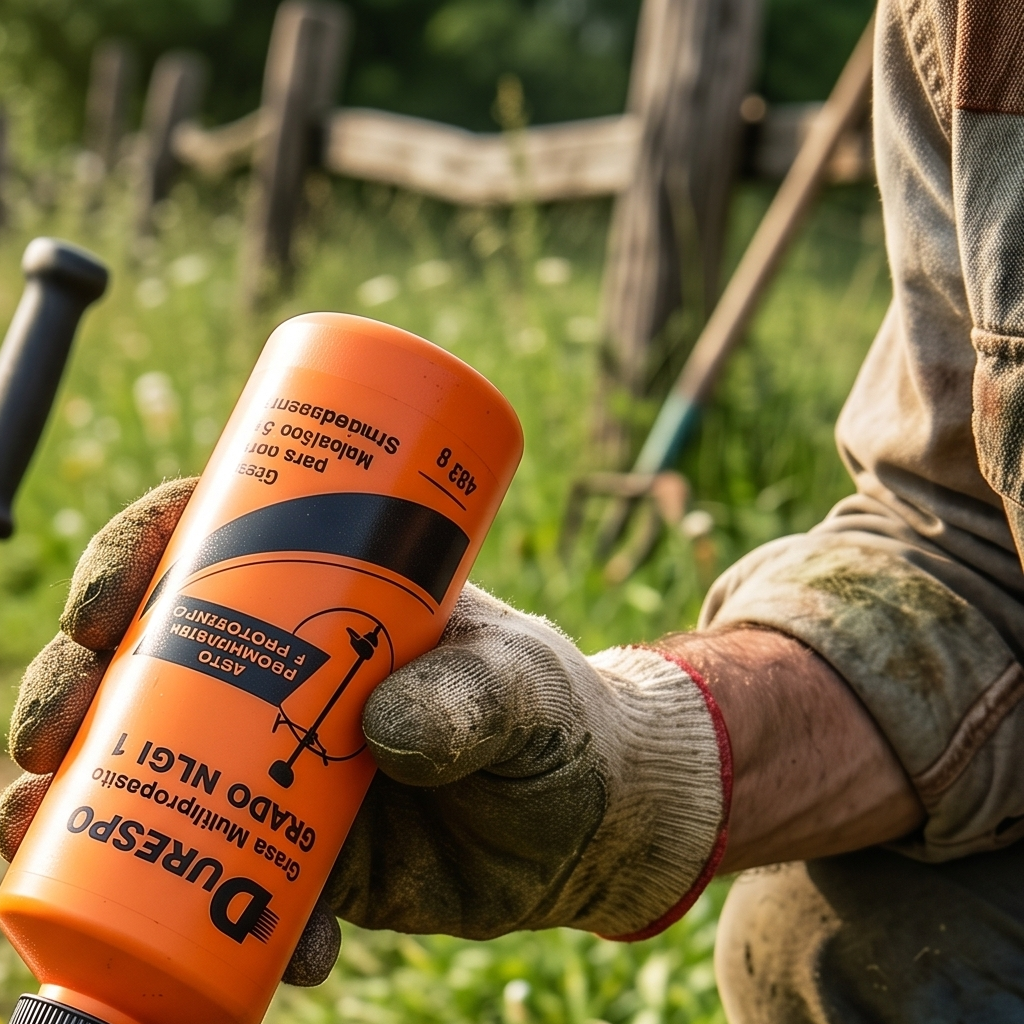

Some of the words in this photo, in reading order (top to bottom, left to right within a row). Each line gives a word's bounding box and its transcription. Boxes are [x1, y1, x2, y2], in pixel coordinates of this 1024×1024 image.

[284, 449, 329, 474] pars
[449, 463, 478, 496] 483
[197, 649, 246, 676] ASTO
[110, 733, 129, 756] 1
[137, 741, 222, 796] NLGI
[227, 783, 316, 853] GRADO
[67, 806, 278, 944] DURESPO
[254, 837, 301, 882] Grasa
